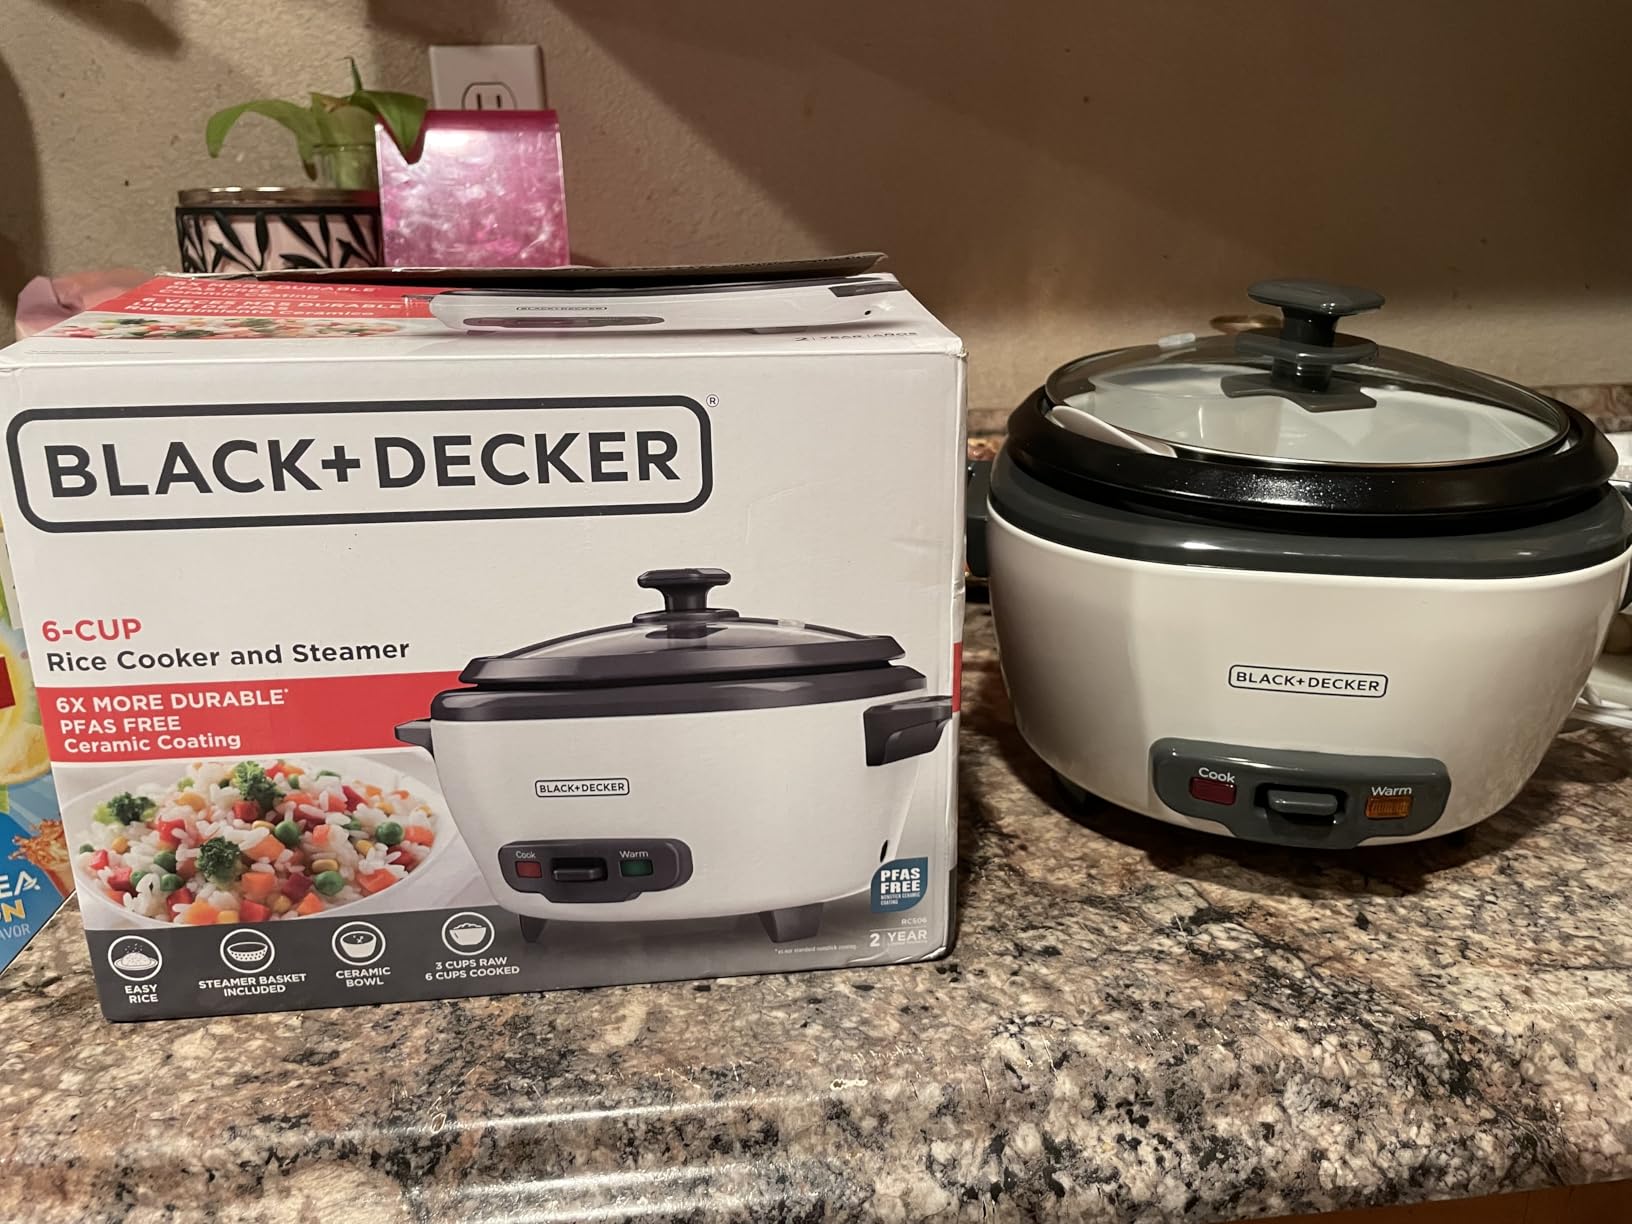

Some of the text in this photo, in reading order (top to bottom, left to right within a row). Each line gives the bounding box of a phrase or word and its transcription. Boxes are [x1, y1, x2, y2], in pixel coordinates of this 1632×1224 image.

[44, 430, 681, 498] BLACK+DECKER
[42, 618, 142, 642] 6-CUP
[47, 643, 410, 671] Rice Cooker and Steamer
[1236, 671, 1380, 692] BLACK+DECKER
[56, 696, 87, 714] 6X
[93, 694, 164, 713] MORE
[60, 715, 182, 735] PFAS FREE
[64, 733, 241, 753] Ceramic Coating
[1198, 767, 1236, 784] Cook
[539, 782, 625, 793] BLACK+DECKER
[1371, 785, 1412, 797] Warm
[515, 850, 649, 859] Cook Warm
[880, 868, 920, 881] PFAS
[880, 880, 920, 894] FREE
[869, 929, 928, 948] 2 YEAR
[435, 957, 508, 970] 3 CUPS RAW
[335, 967, 391, 979] CERAMIC
[425, 966, 520, 981] 6 CUPS COOKED
[198, 973, 307, 989] STEAMER BASKET
[346, 977, 384, 988] BOWL
[124, 984, 158, 995] EASY
[223, 984, 287, 997] INCLUDED
[128, 994, 159, 1004] RICE
